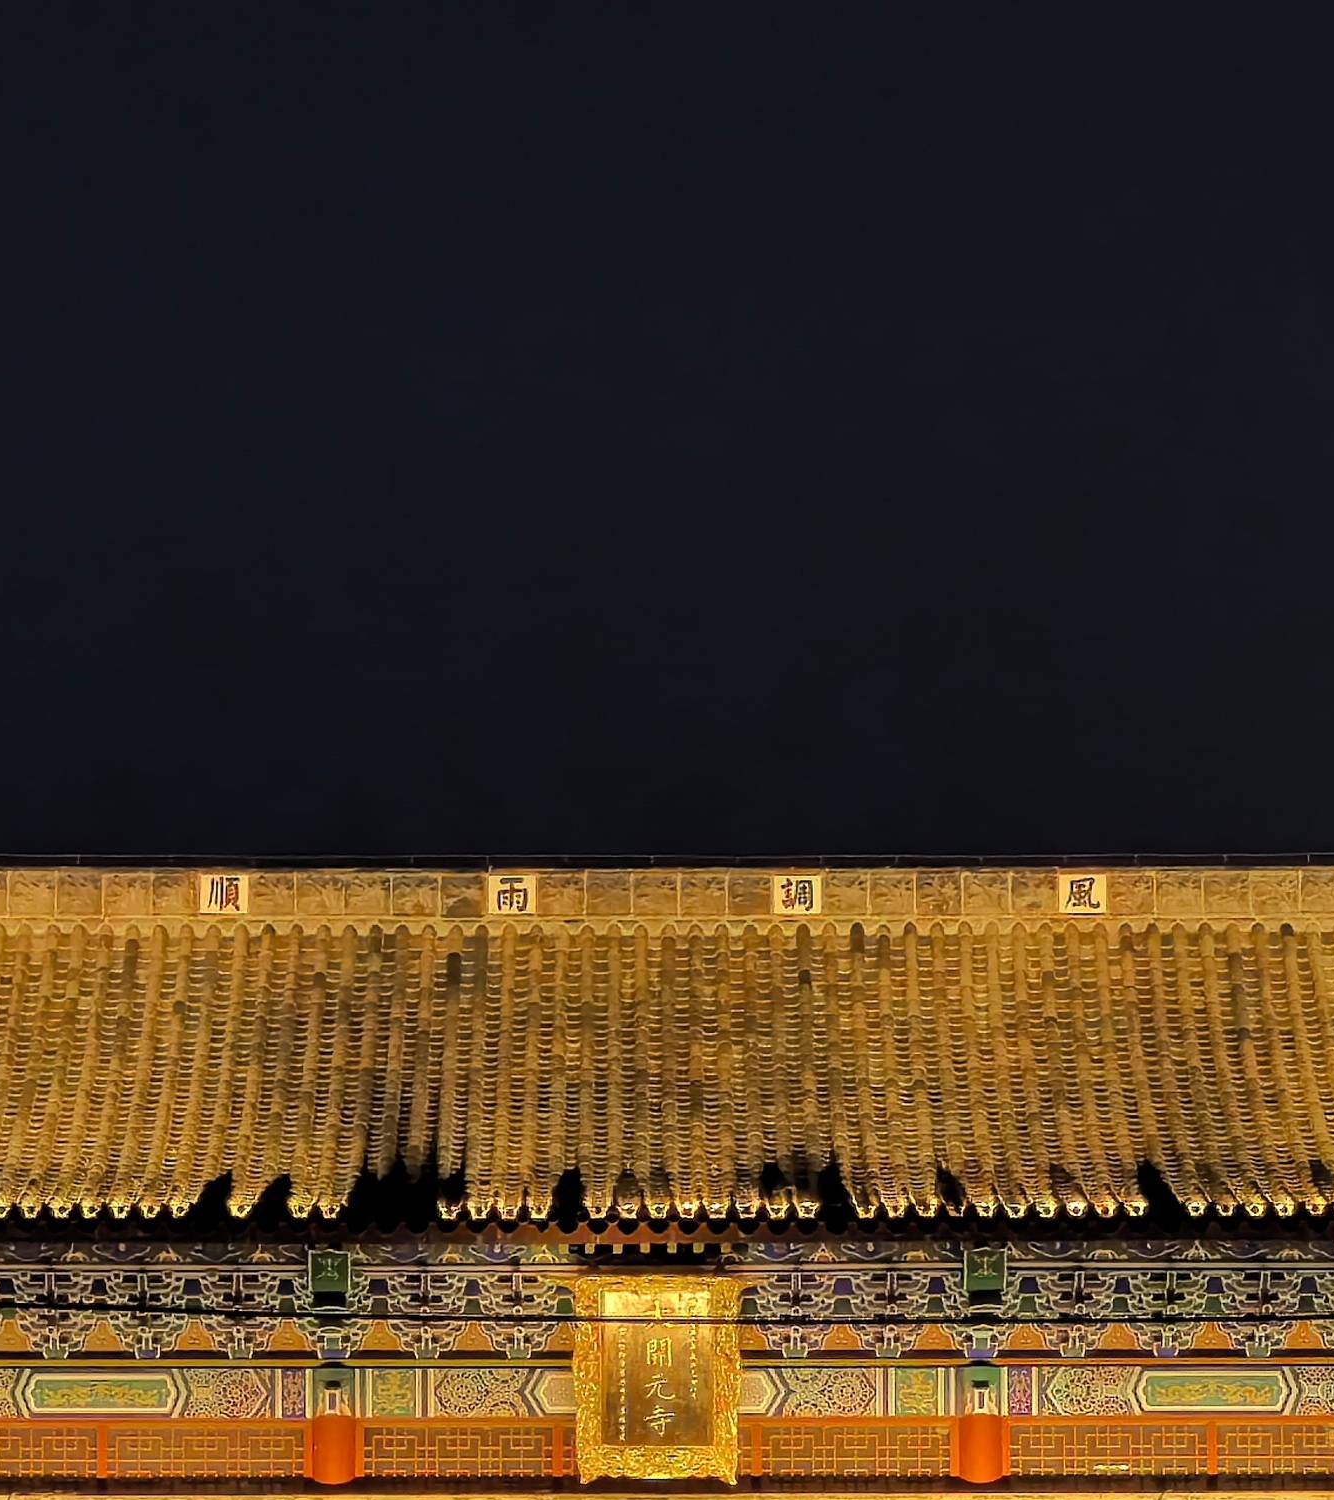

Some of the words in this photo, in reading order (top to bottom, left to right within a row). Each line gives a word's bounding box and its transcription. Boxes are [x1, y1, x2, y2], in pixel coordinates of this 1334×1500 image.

[208, 876, 240, 911] 順
[497, 877, 528, 911] 雨
[781, 878, 813, 911] 調
[1065, 877, 1100, 909] 風
